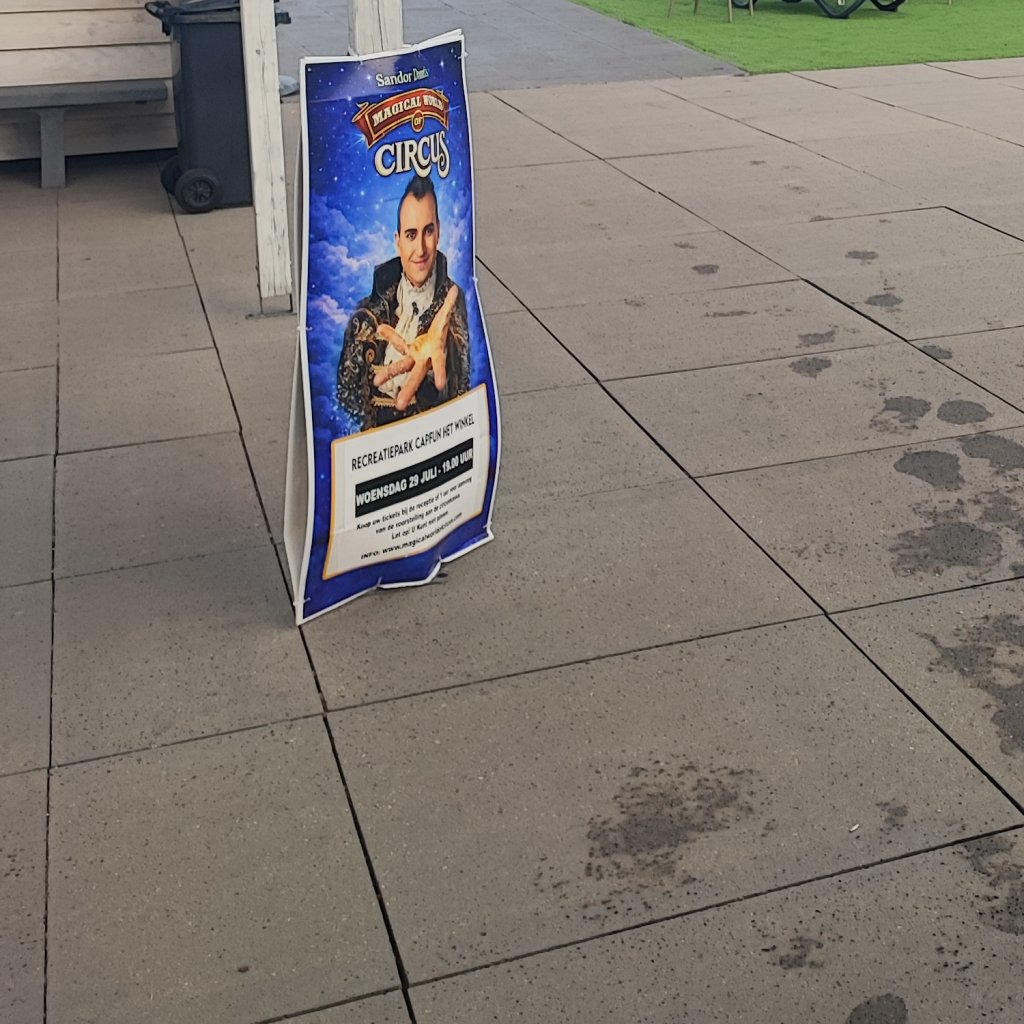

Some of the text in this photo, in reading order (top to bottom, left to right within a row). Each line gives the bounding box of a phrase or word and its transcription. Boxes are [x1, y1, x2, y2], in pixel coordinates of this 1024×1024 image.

[376, 70, 412, 87] Sandor
[372, 96, 422, 127] MAGICAL
[414, 116, 422, 126] OF
[375, 130, 449, 178] CIRCUS
[352, 413, 475, 471] RECREATIEPARK CAPFUN HET WINKEL
[356, 479, 407, 507] WOENSDAG
[409, 474, 419, 488] 29
[420, 466, 437, 484] JULI
[442, 455, 459, 474] 19.00
[460, 448, 473, 464] UUR
[382, 511, 400, 523] tickets
[409, 505, 415, 513] de
[416, 498, 434, 509] receptie
[396, 514, 424, 528] voorstelling
[392, 531, 401, 540] Let
